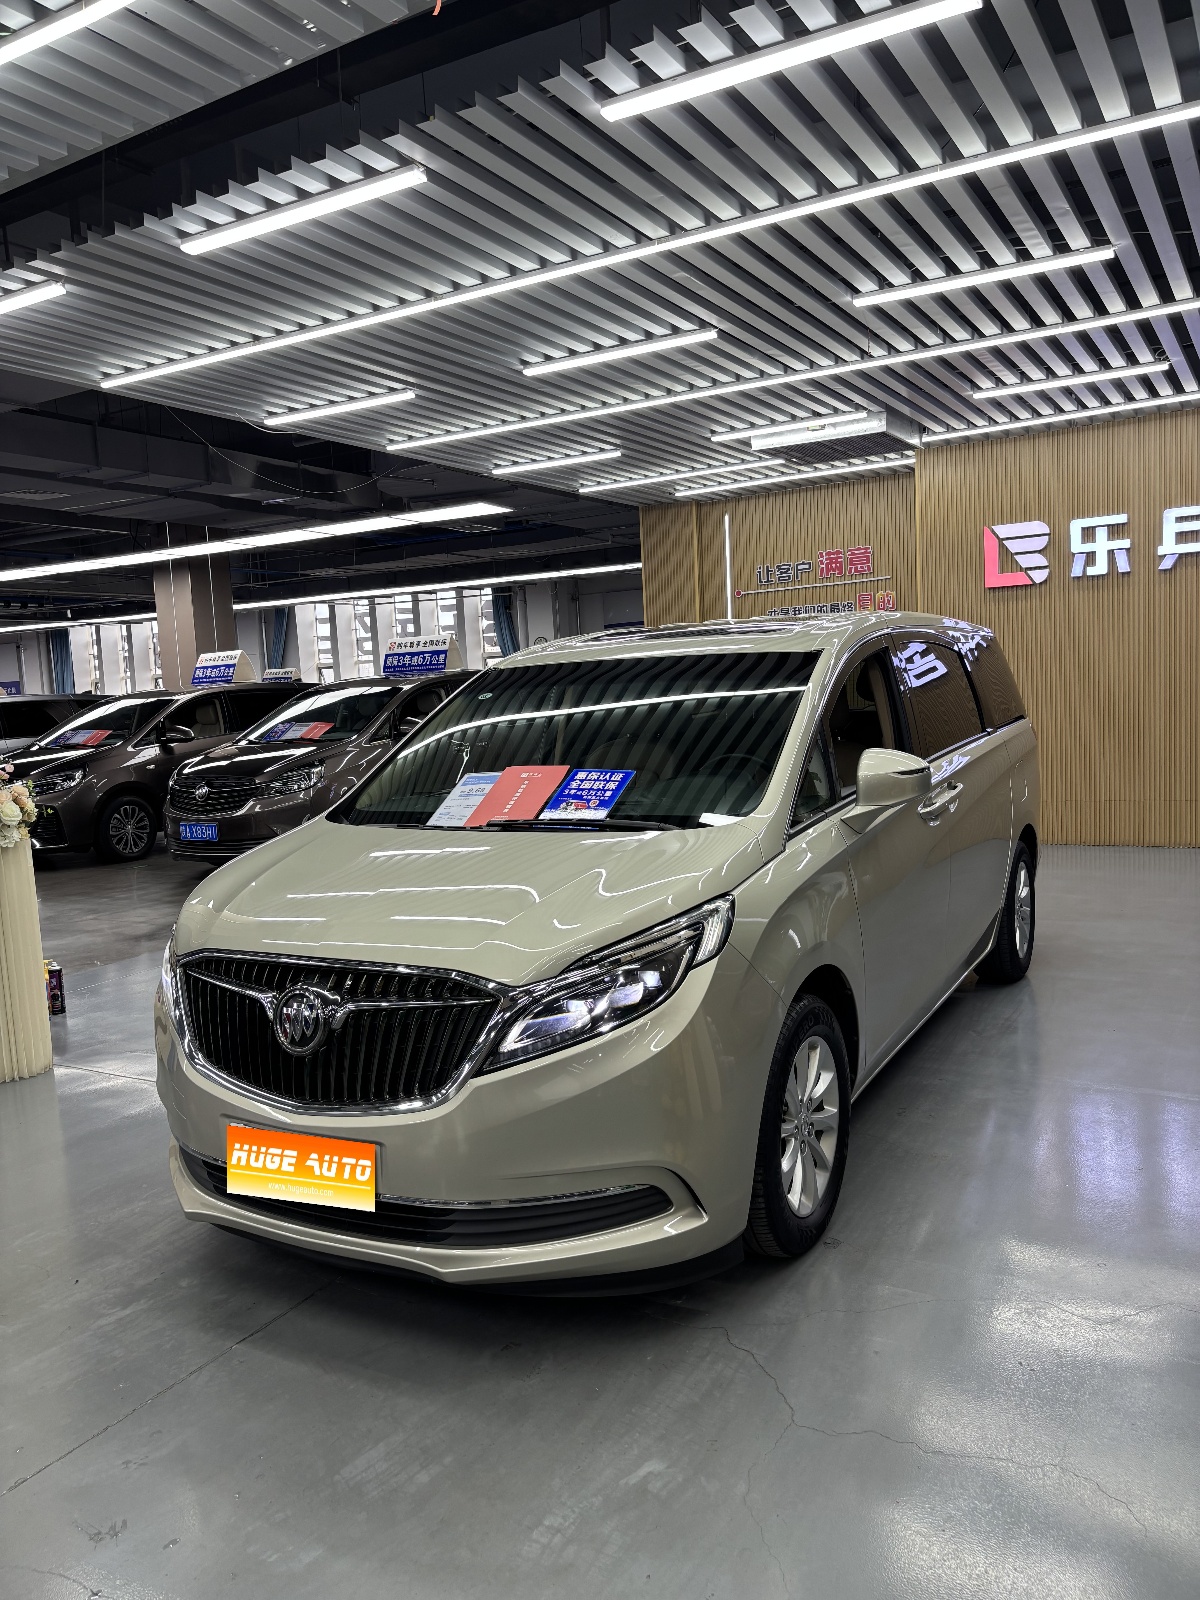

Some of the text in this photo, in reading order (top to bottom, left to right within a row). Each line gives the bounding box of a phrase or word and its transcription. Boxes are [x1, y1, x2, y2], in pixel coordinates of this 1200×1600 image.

[385, 654, 446, 667] 质保3年或6万公里
[574, 771, 626, 782] 惠保认证
[567, 780, 620, 790] 全国联保
